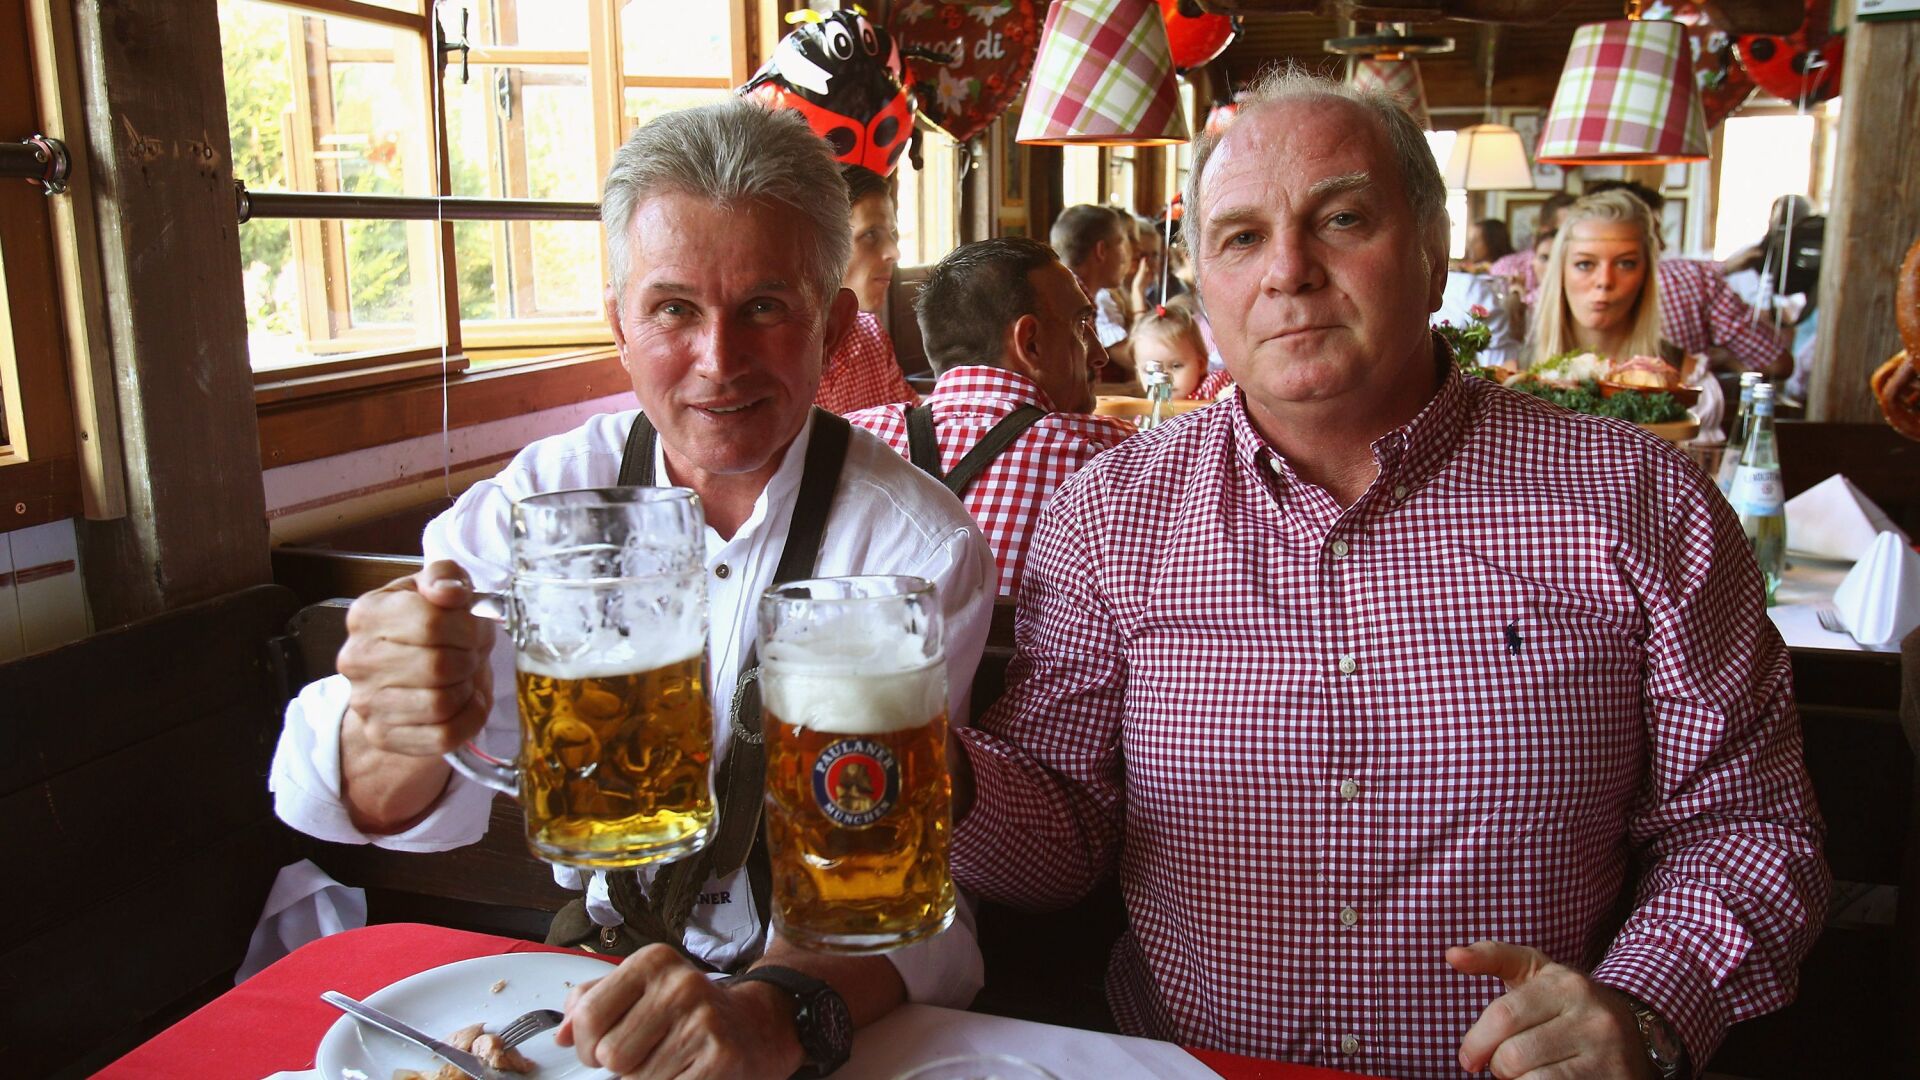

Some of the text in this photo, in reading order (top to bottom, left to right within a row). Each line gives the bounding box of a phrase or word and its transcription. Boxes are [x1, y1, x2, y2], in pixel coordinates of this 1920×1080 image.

[974, 29, 1006, 60] di
[816, 740, 895, 774] PAULANER
[698, 891, 732, 905] NER
